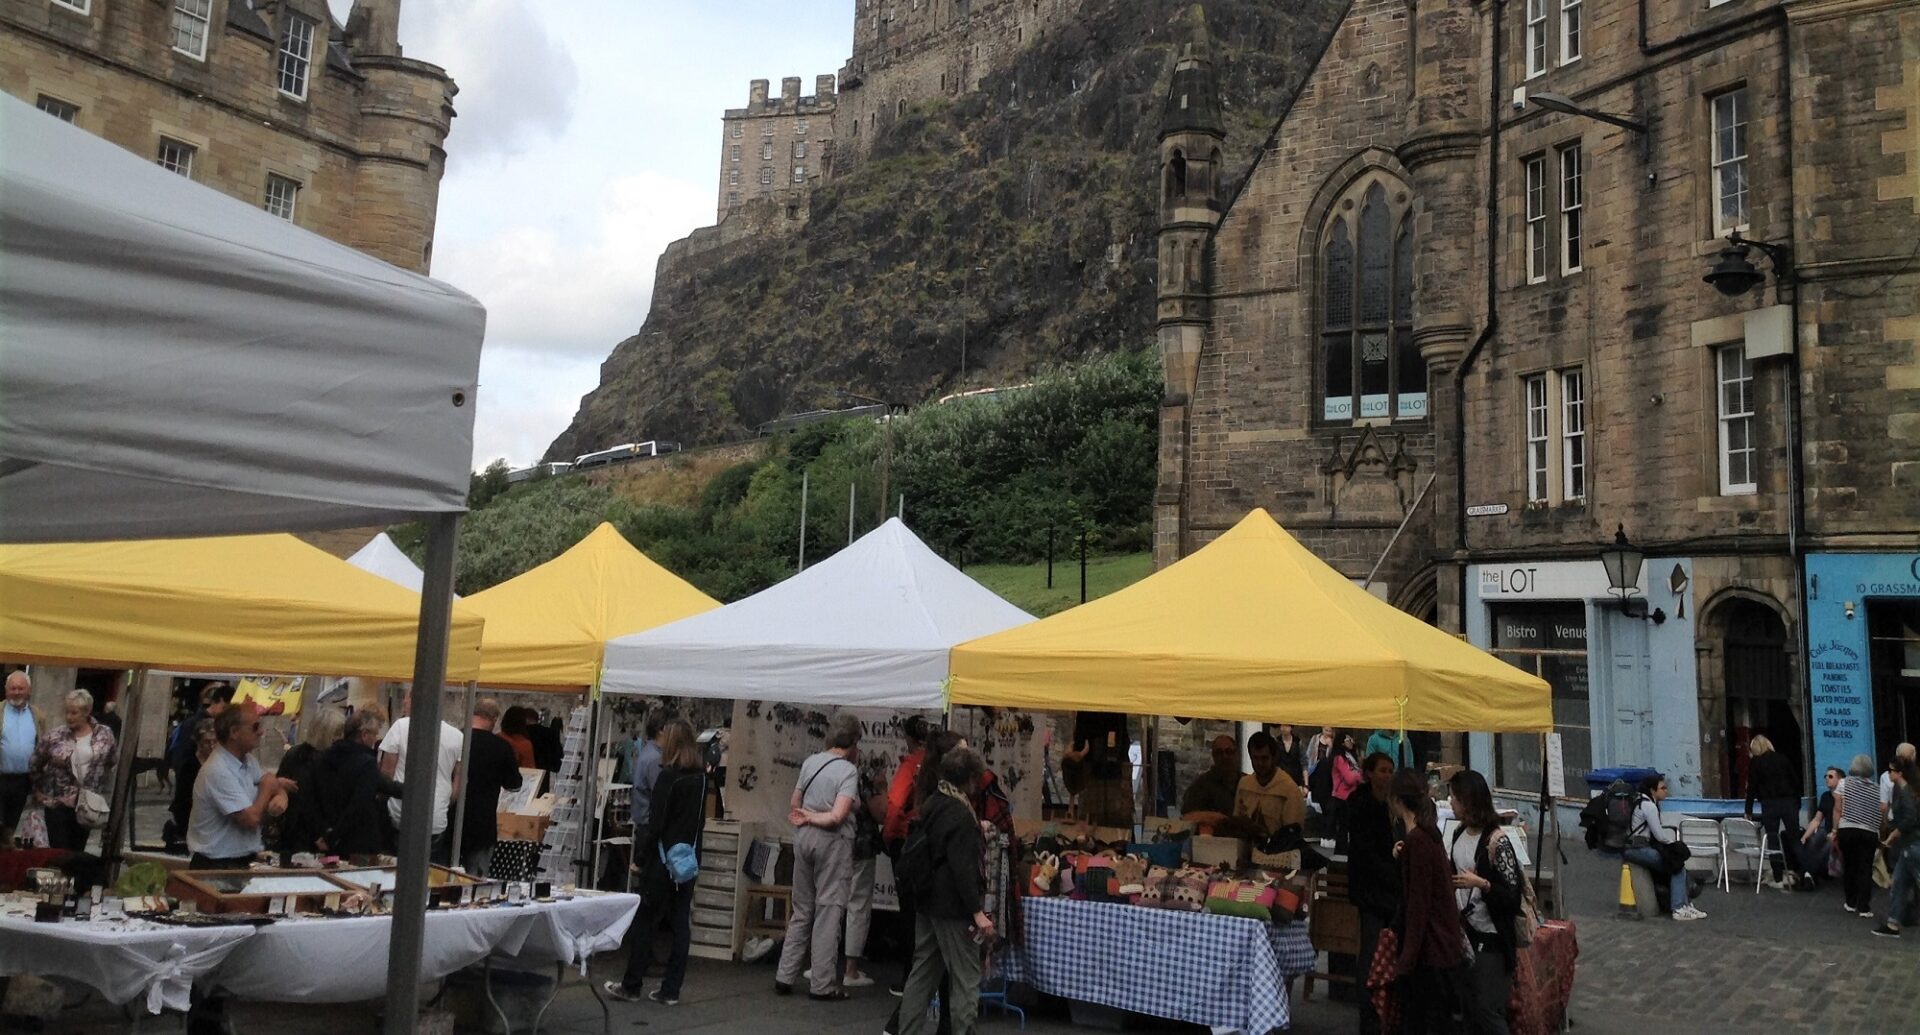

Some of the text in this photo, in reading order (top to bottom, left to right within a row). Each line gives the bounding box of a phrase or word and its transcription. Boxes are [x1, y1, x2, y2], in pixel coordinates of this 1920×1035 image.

[1334, 403, 1350, 413] LOT
[1370, 401, 1387, 411] LOT
[1408, 400, 1426, 410] LOT
[1468, 505, 1506, 514] GRASSMARKET
[1482, 568, 1537, 593] the LOT
[1856, 584, 1866, 593] 10
[1507, 625, 1588, 638] Bistro Venue
[1821, 684, 1851, 694] TOASTIES
[1813, 695, 1861, 704] BAKED POTATOES
[1825, 708, 1851, 716] SALADS
[1817, 718, 1859, 728] FISH & CHIPS
[1823, 730, 1853, 739] BURGERS
